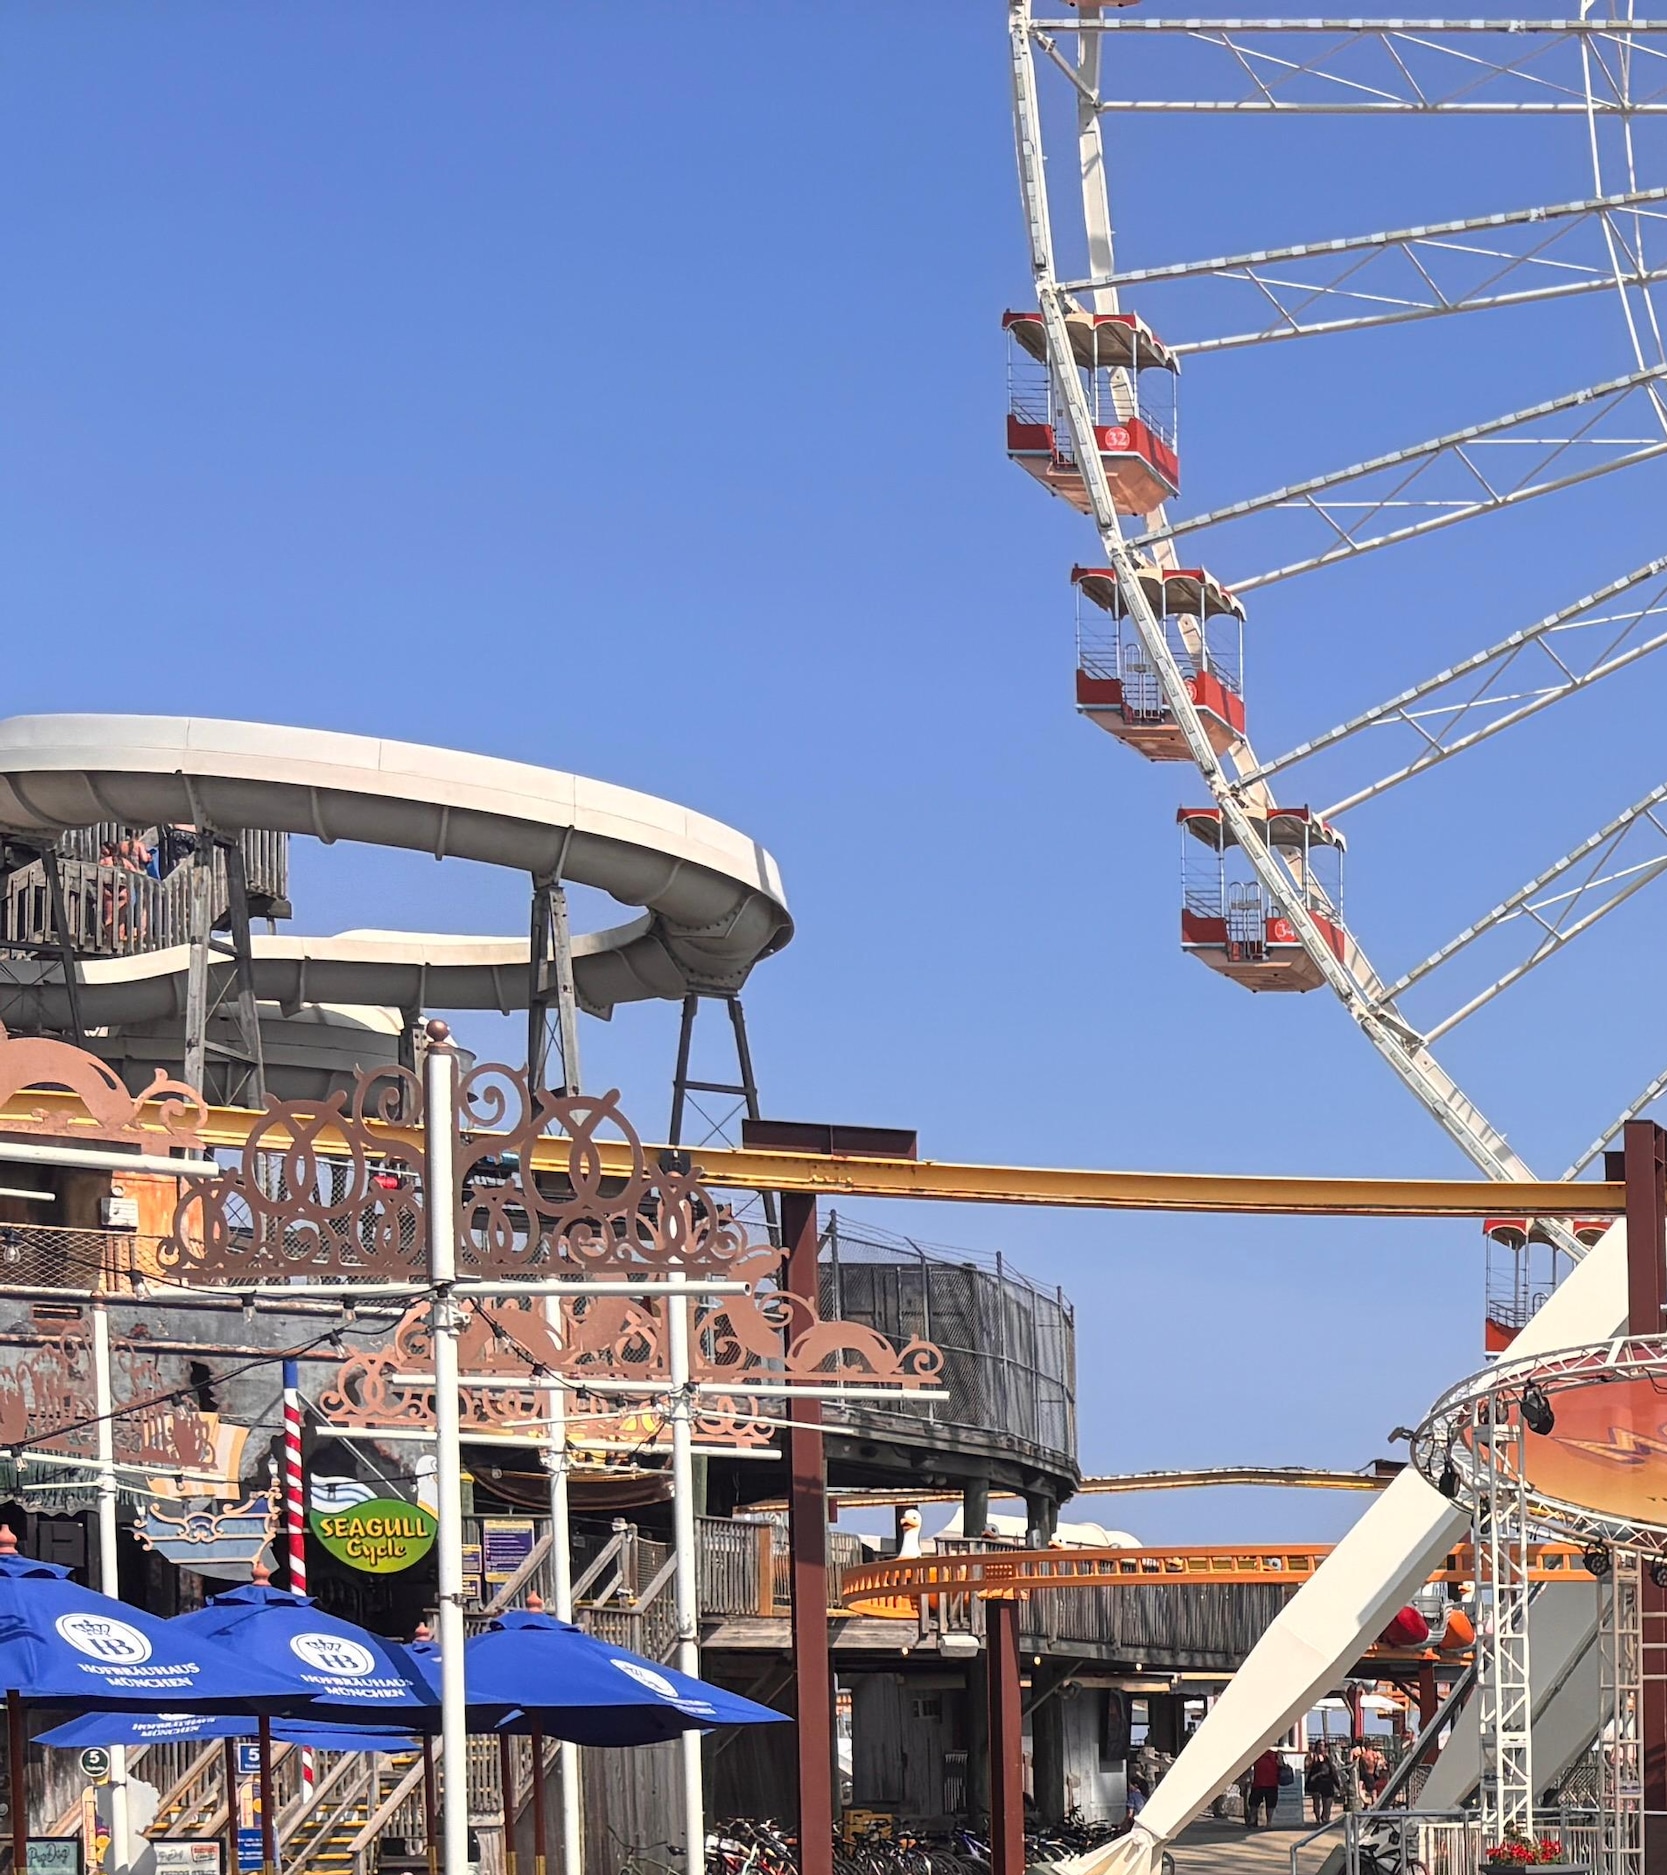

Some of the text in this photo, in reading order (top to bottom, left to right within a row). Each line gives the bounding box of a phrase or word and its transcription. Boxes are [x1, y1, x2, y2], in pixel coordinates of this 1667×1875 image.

[1108, 431, 1128, 446] 32
[320, 1517, 429, 1540] SEAGULL
[346, 1538, 408, 1567] Cycle
[88, 1637, 136, 1656] HB
[89, 1750, 100, 1764] 5
[247, 1747, 261, 1762] 5
